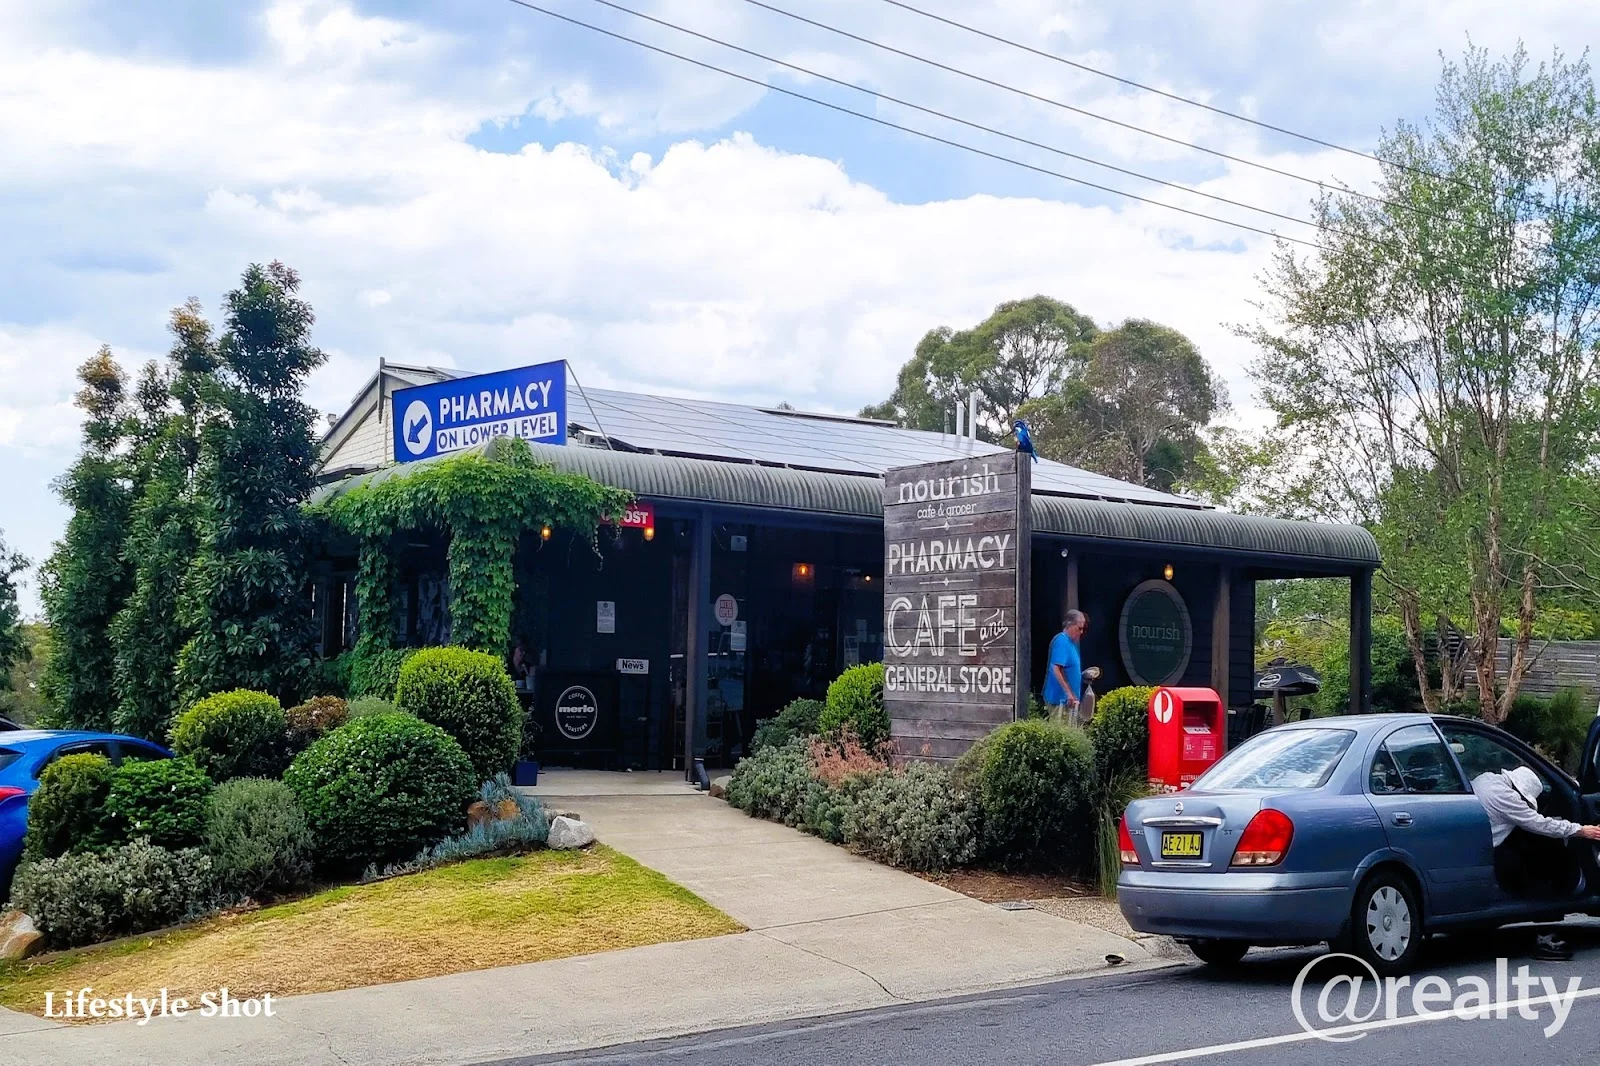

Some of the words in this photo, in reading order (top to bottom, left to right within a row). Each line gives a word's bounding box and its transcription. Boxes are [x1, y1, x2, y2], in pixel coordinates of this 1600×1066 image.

[439, 380, 552, 424] PHARMACY
[438, 430, 458, 449] ON
[514, 416, 555, 438] LEVEL
[897, 464, 1000, 504] nourish
[623, 509, 649, 525] OST
[917, 504, 936, 519] cafe
[937, 503, 945, 517] &
[945, 502, 977, 519] grocer
[888, 534, 1011, 574] PHARMACY
[887, 594, 978, 657] CAFE
[979, 609, 1009, 652] and
[1132, 622, 1181, 640] nourish
[622, 659, 645, 670] News
[885, 665, 956, 693] GENERAL
[959, 666, 1012, 694] STORE
[558, 704, 595, 713] merlo
